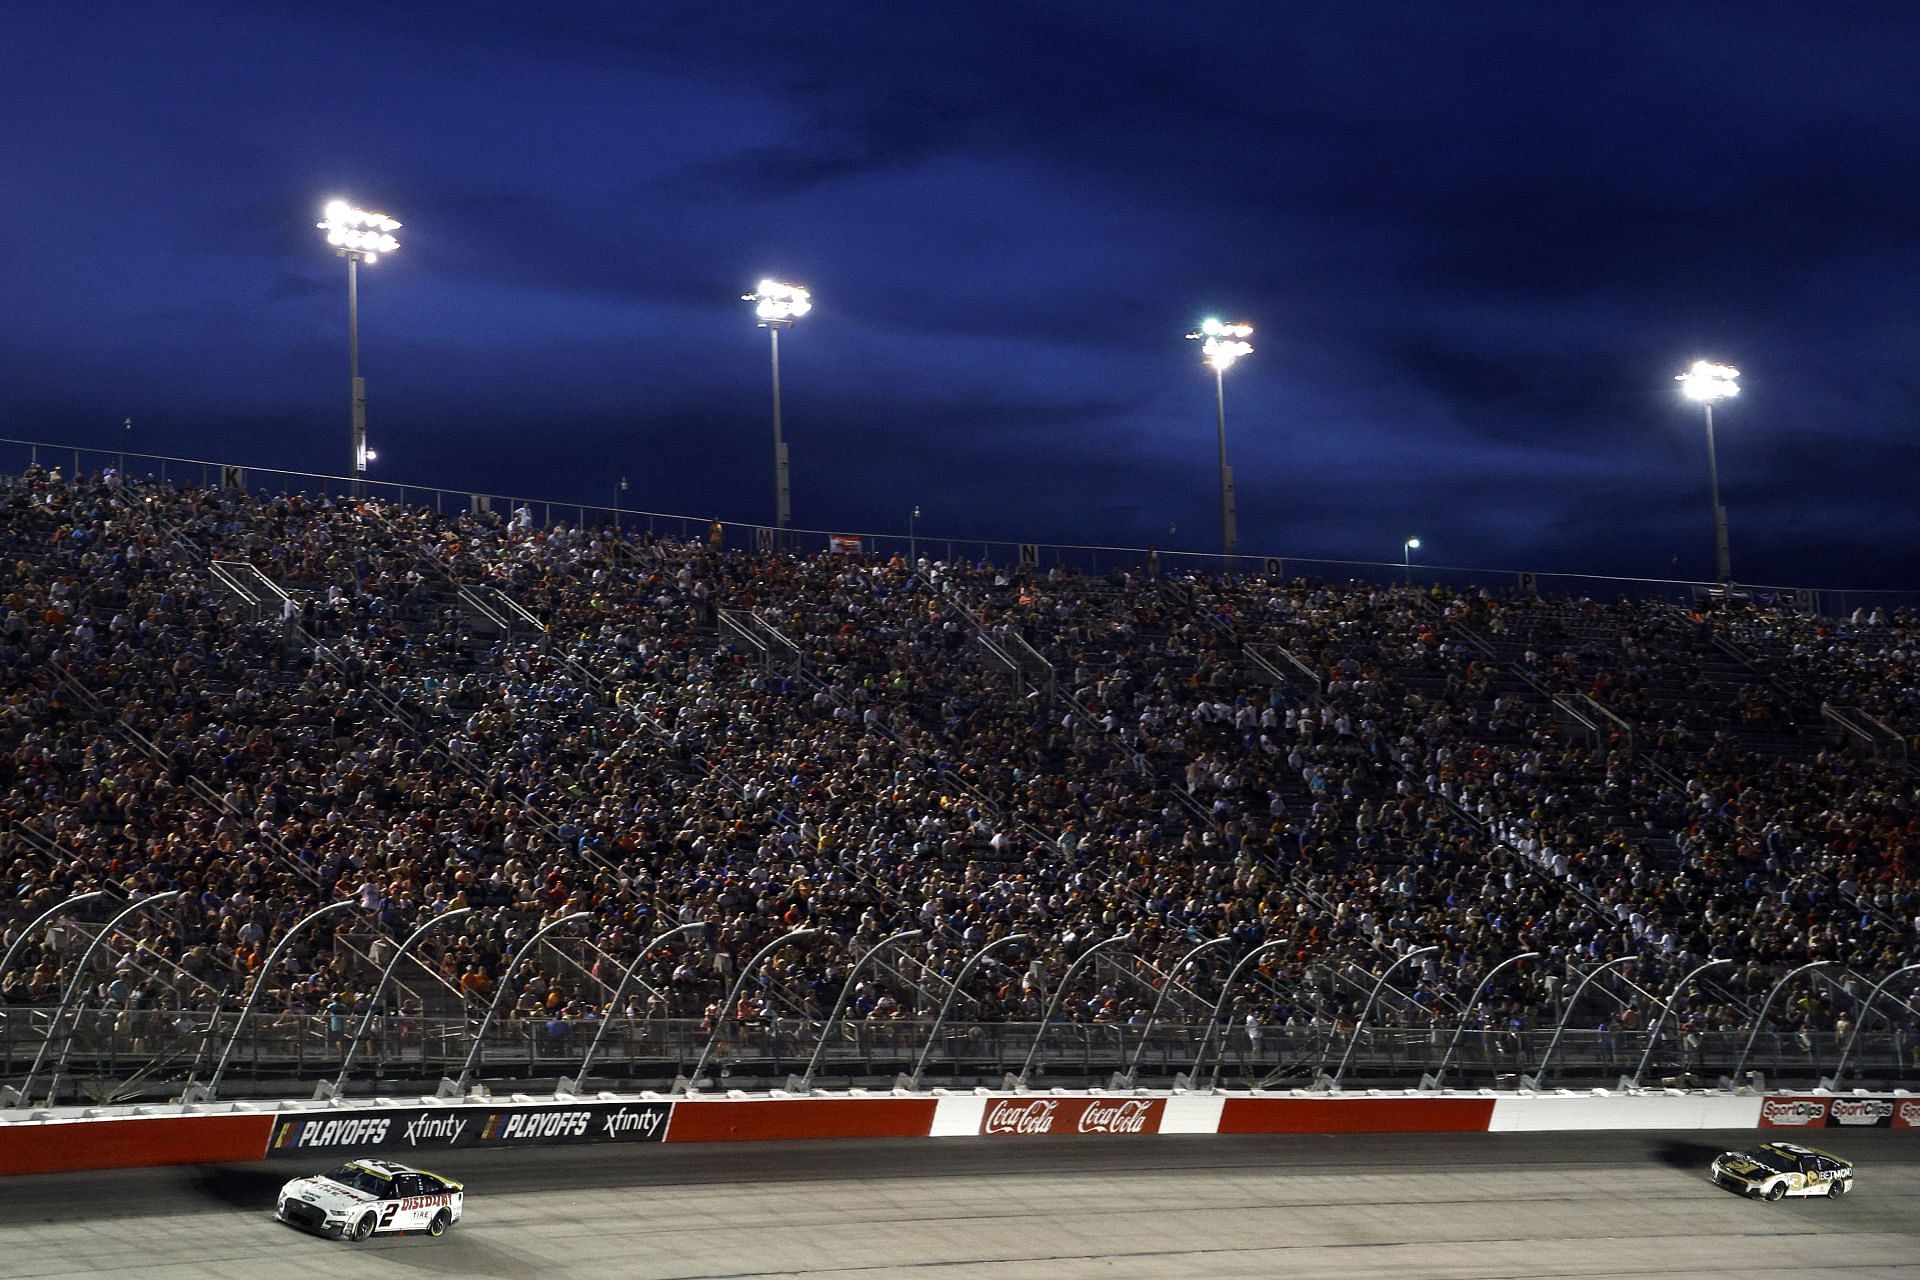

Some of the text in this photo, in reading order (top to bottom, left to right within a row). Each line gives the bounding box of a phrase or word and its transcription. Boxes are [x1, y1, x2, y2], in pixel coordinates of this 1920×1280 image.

[298, 1112, 467, 1147] PLAYOFFS xfinity
[503, 1107, 664, 1139] PLAYOFFS xfinity
[1790, 1174, 1802, 1191] 3
[379, 1203, 399, 1227] 2
